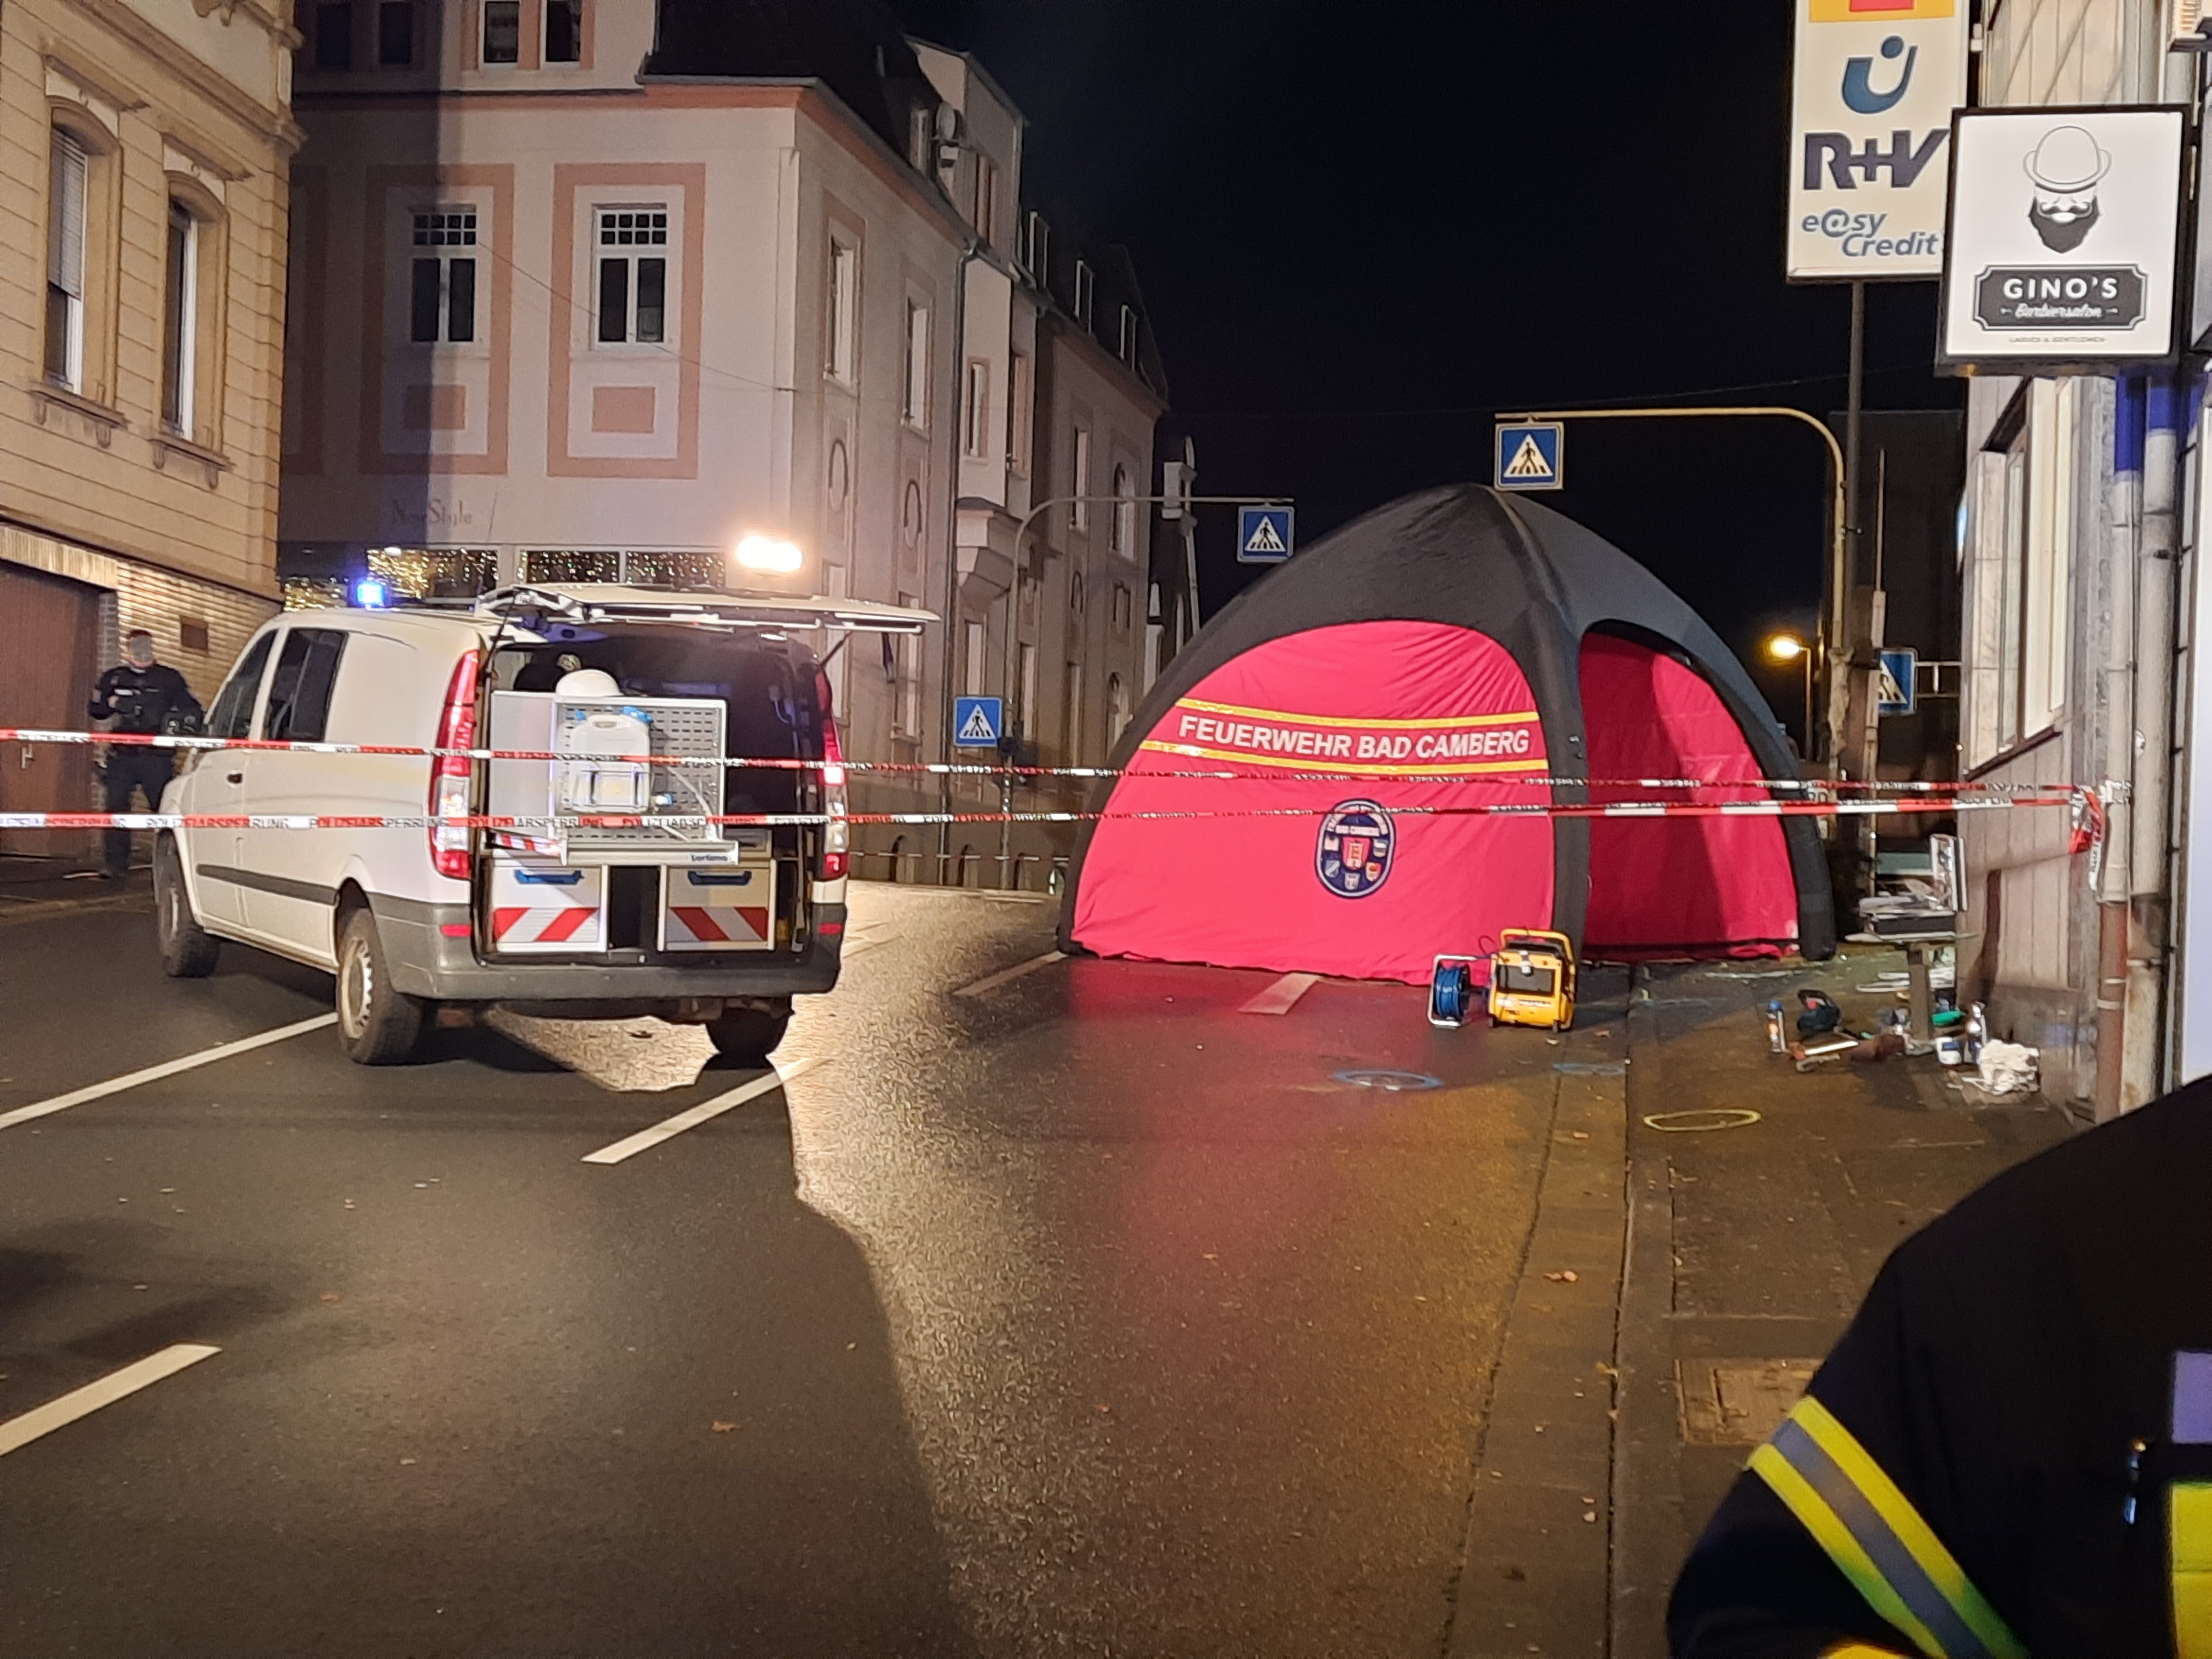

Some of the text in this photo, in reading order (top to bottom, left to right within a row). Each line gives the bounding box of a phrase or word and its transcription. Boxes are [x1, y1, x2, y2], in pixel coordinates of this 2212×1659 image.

[1803, 128, 1950, 190] R+V
[1802, 209, 1889, 238] e@sy
[1842, 232, 1940, 257] Credit
[2003, 276, 2118, 299] GINO'S
[1179, 715, 1529, 758] FEUERWEHR BAD CAMBERG
